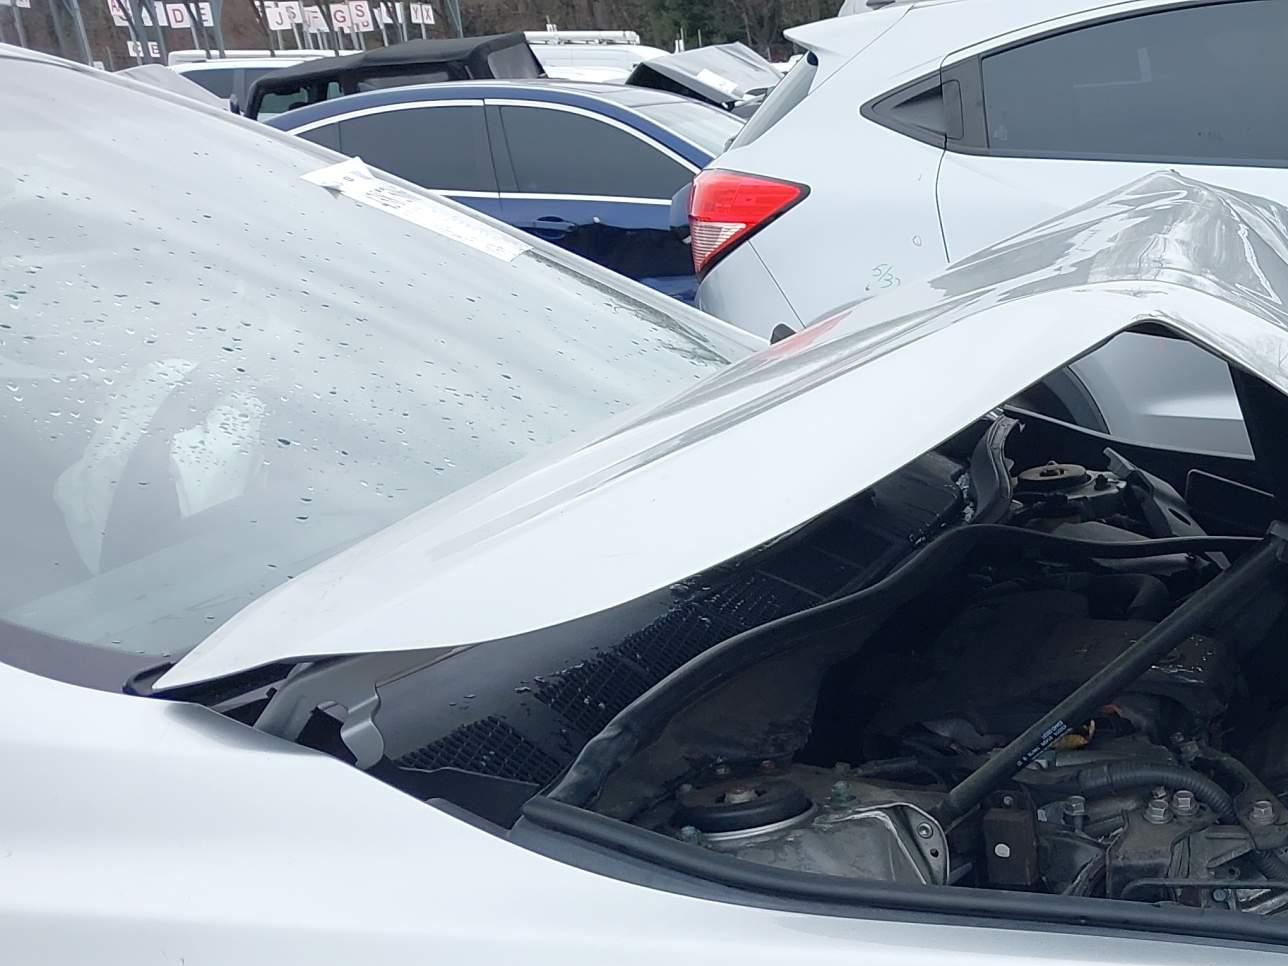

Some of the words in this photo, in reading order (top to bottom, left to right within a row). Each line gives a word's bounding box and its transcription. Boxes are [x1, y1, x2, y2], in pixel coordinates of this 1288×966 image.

[172, 8, 184, 23] D
[333, 9, 347, 23] G
[354, 4, 365, 18] S
